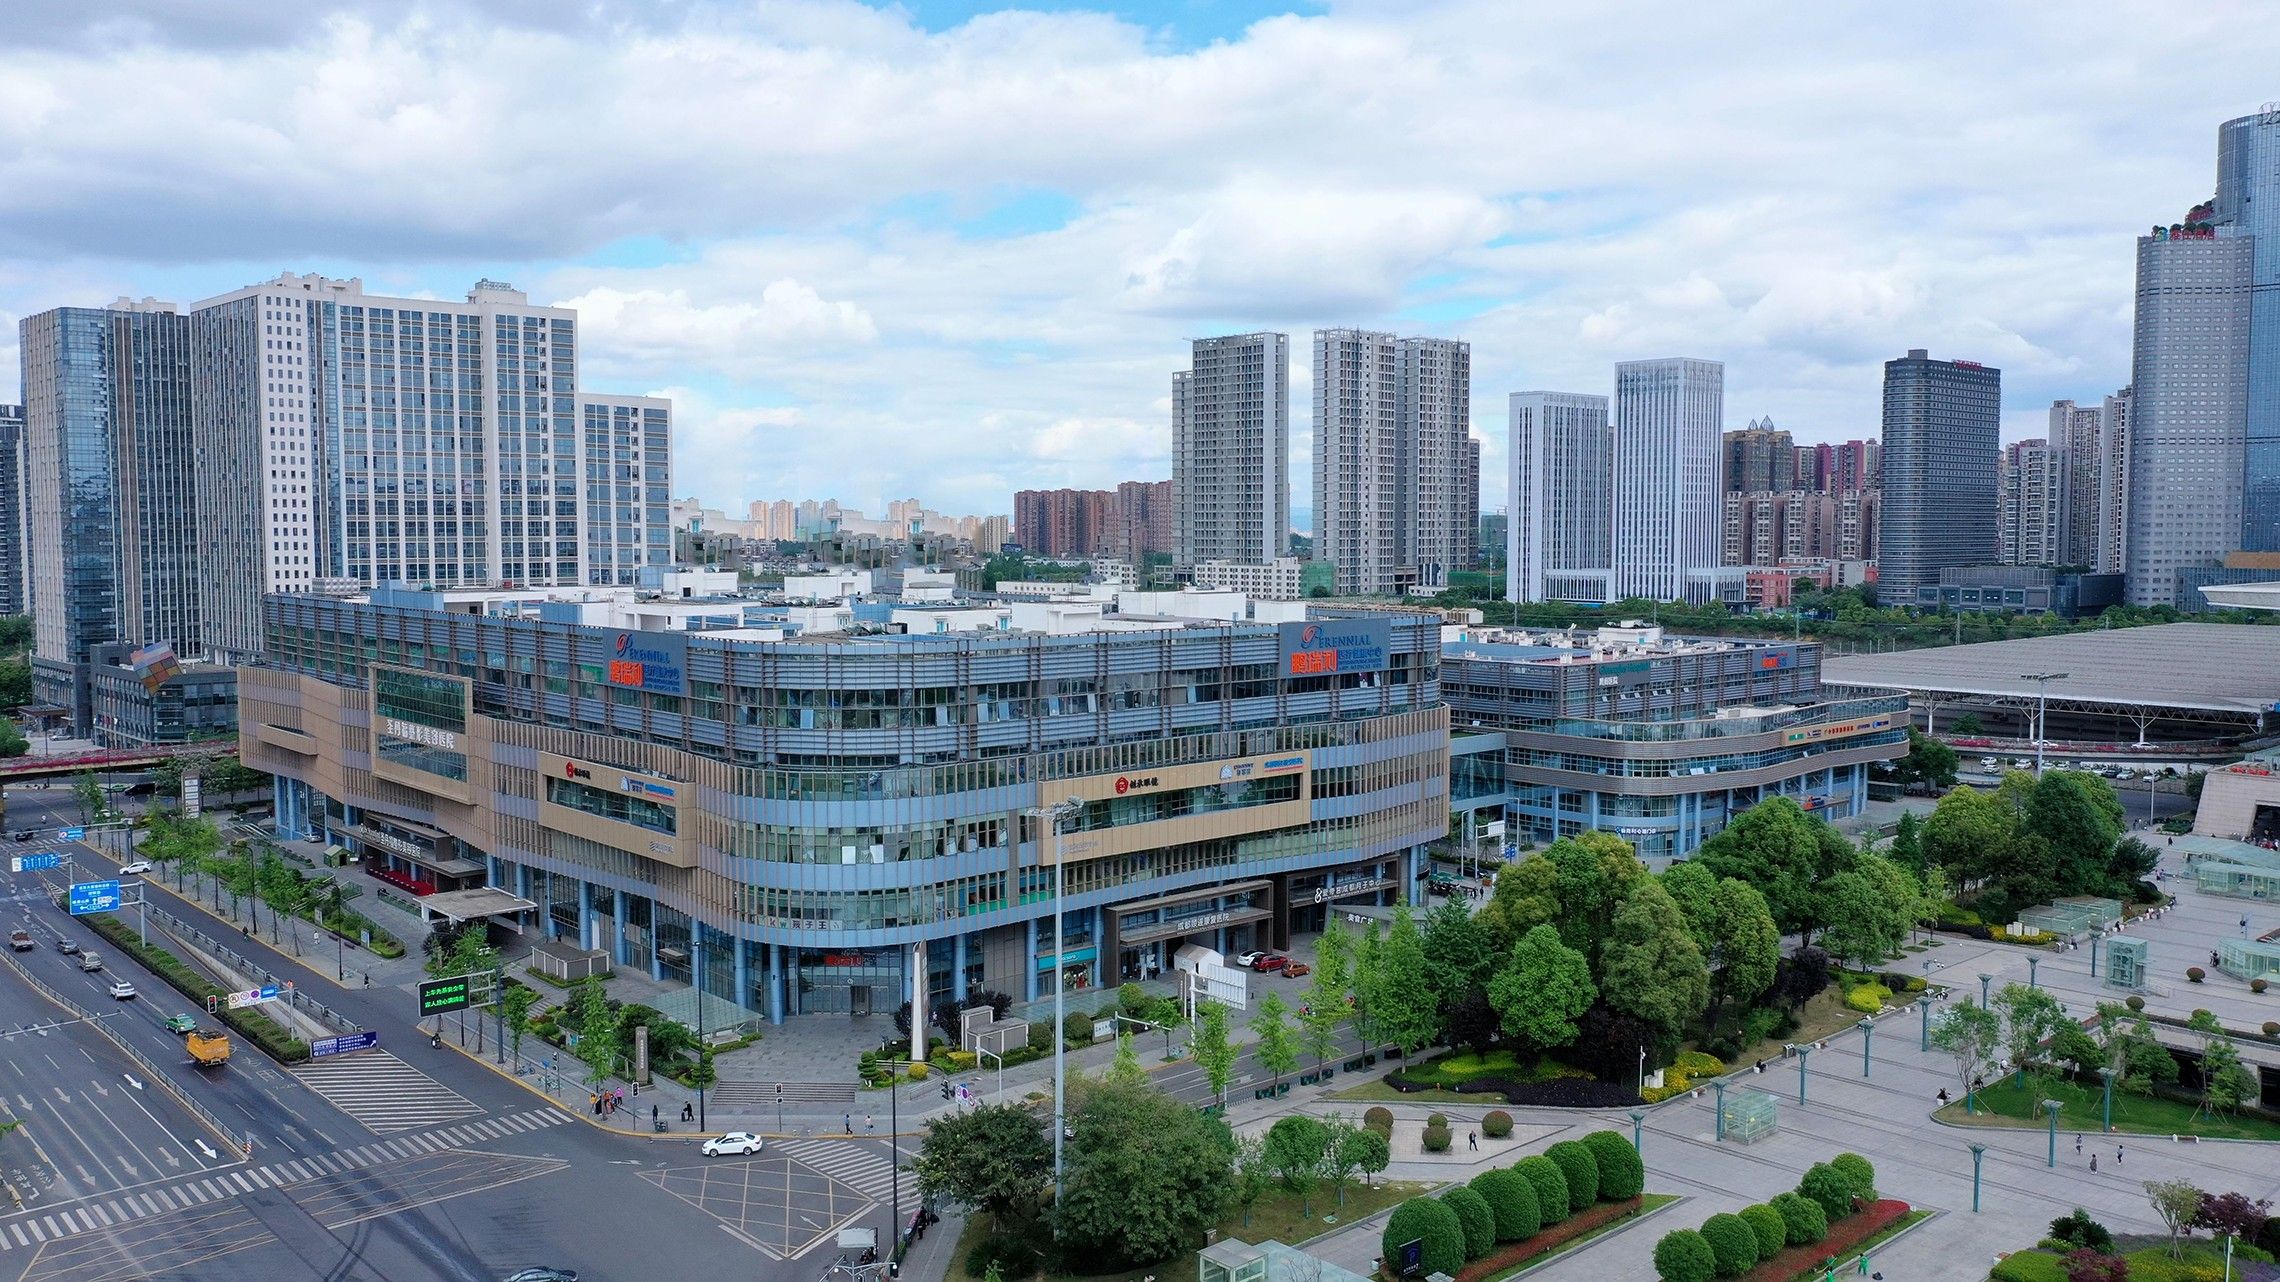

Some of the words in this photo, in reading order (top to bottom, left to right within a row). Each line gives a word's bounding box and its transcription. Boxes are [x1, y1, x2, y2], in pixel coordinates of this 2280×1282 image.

[1300, 625, 1371, 649] PERENNIAL
[608, 660, 644, 688] 鹏瑞利
[1290, 648, 1338, 675] 鹏瑞利
